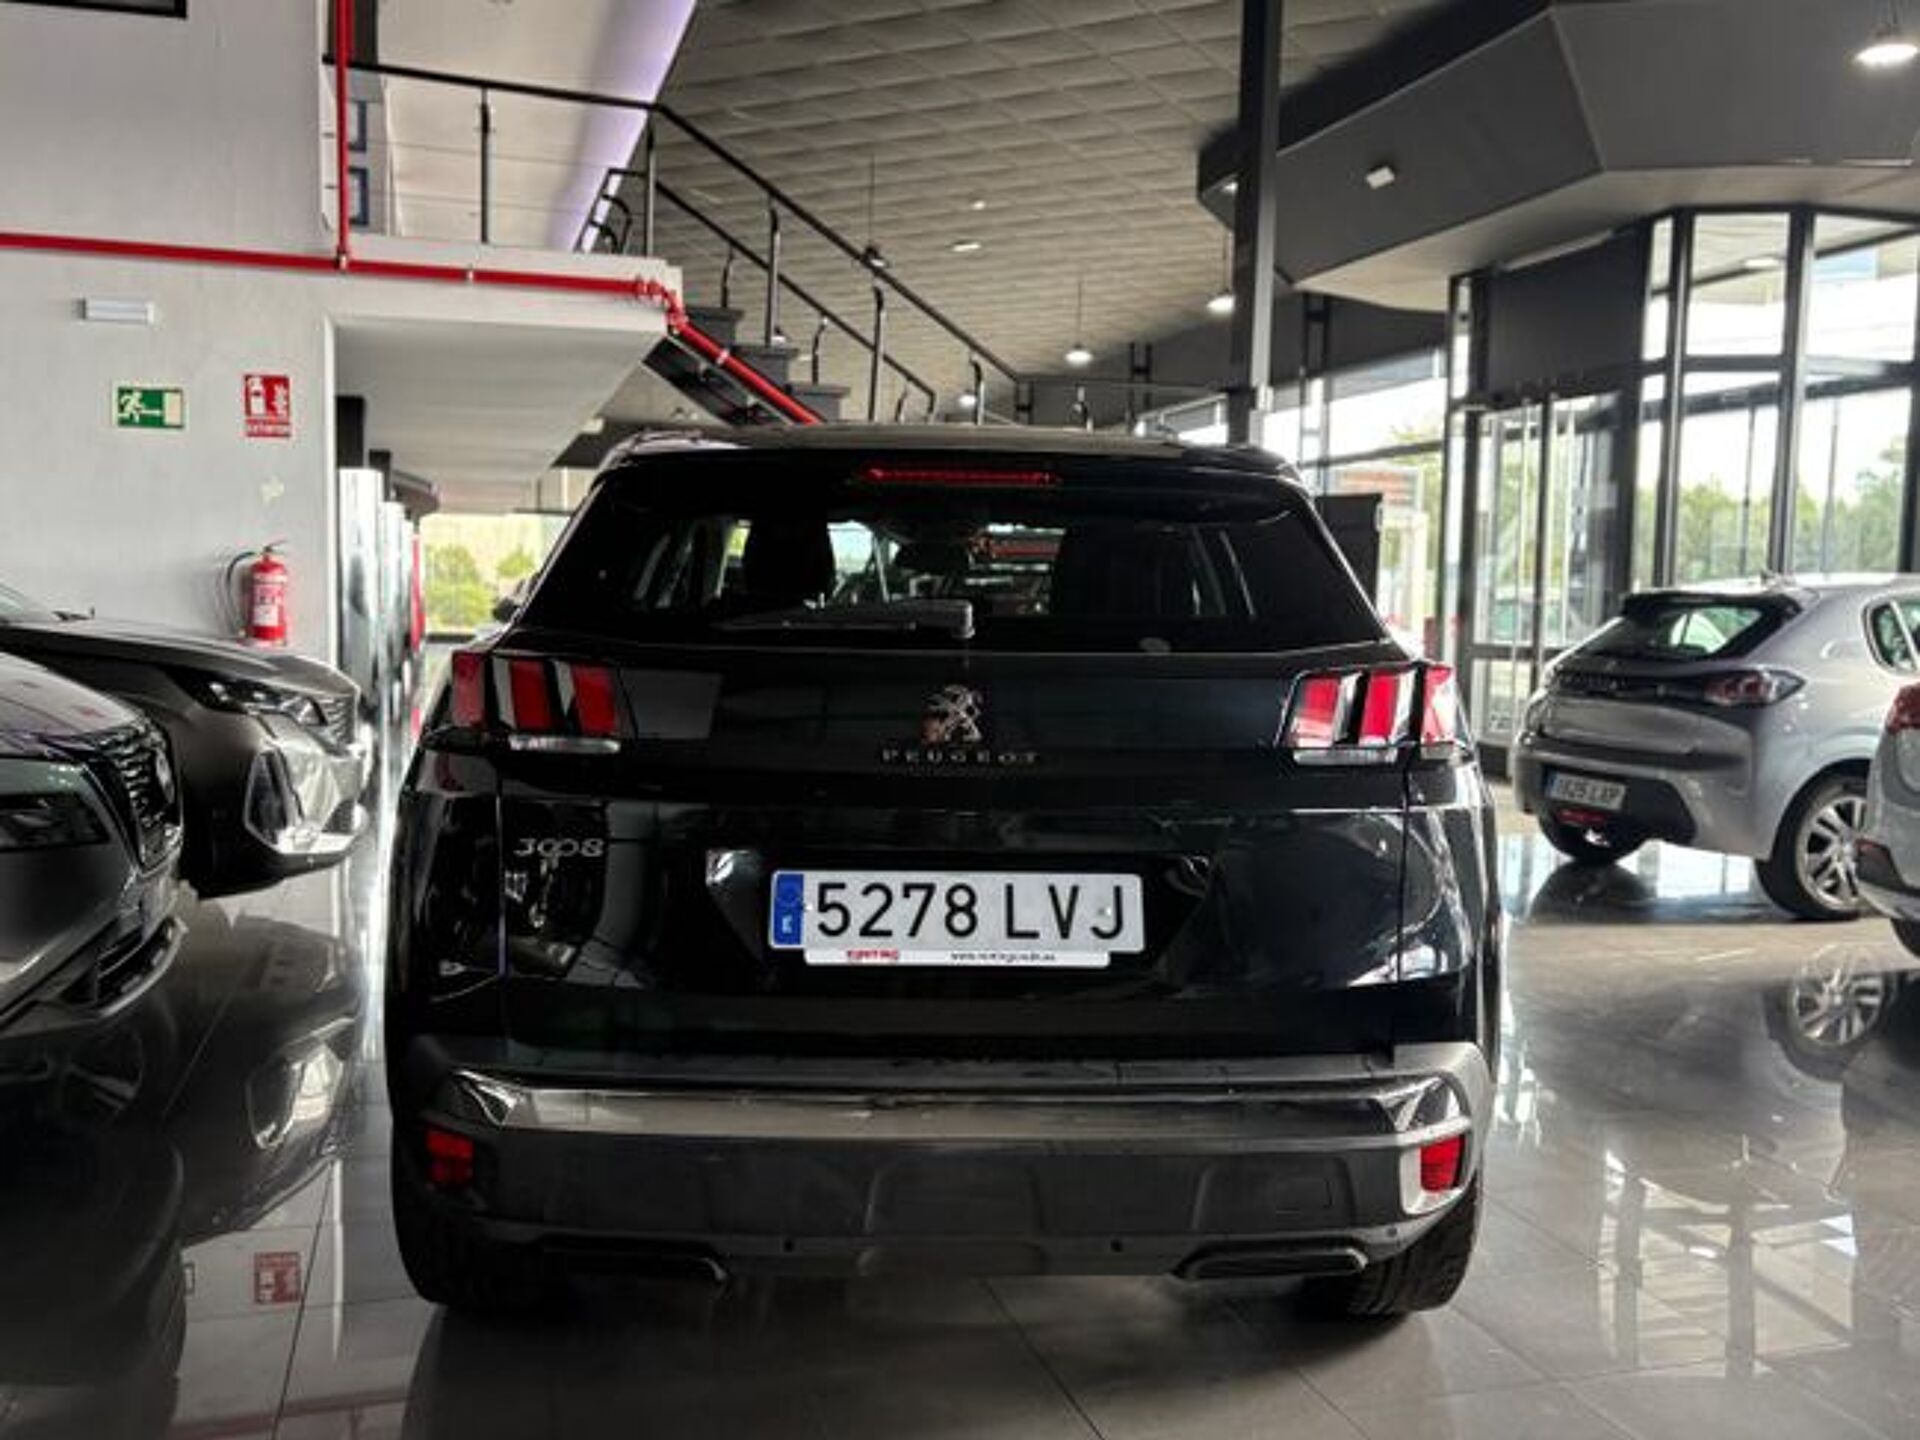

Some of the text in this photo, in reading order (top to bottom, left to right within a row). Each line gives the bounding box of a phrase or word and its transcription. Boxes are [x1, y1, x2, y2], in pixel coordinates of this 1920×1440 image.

[882, 750, 1037, 764] PEUGEOT
[817, 882, 978, 938] 5278
[1004, 883, 1123, 940] LVJ
